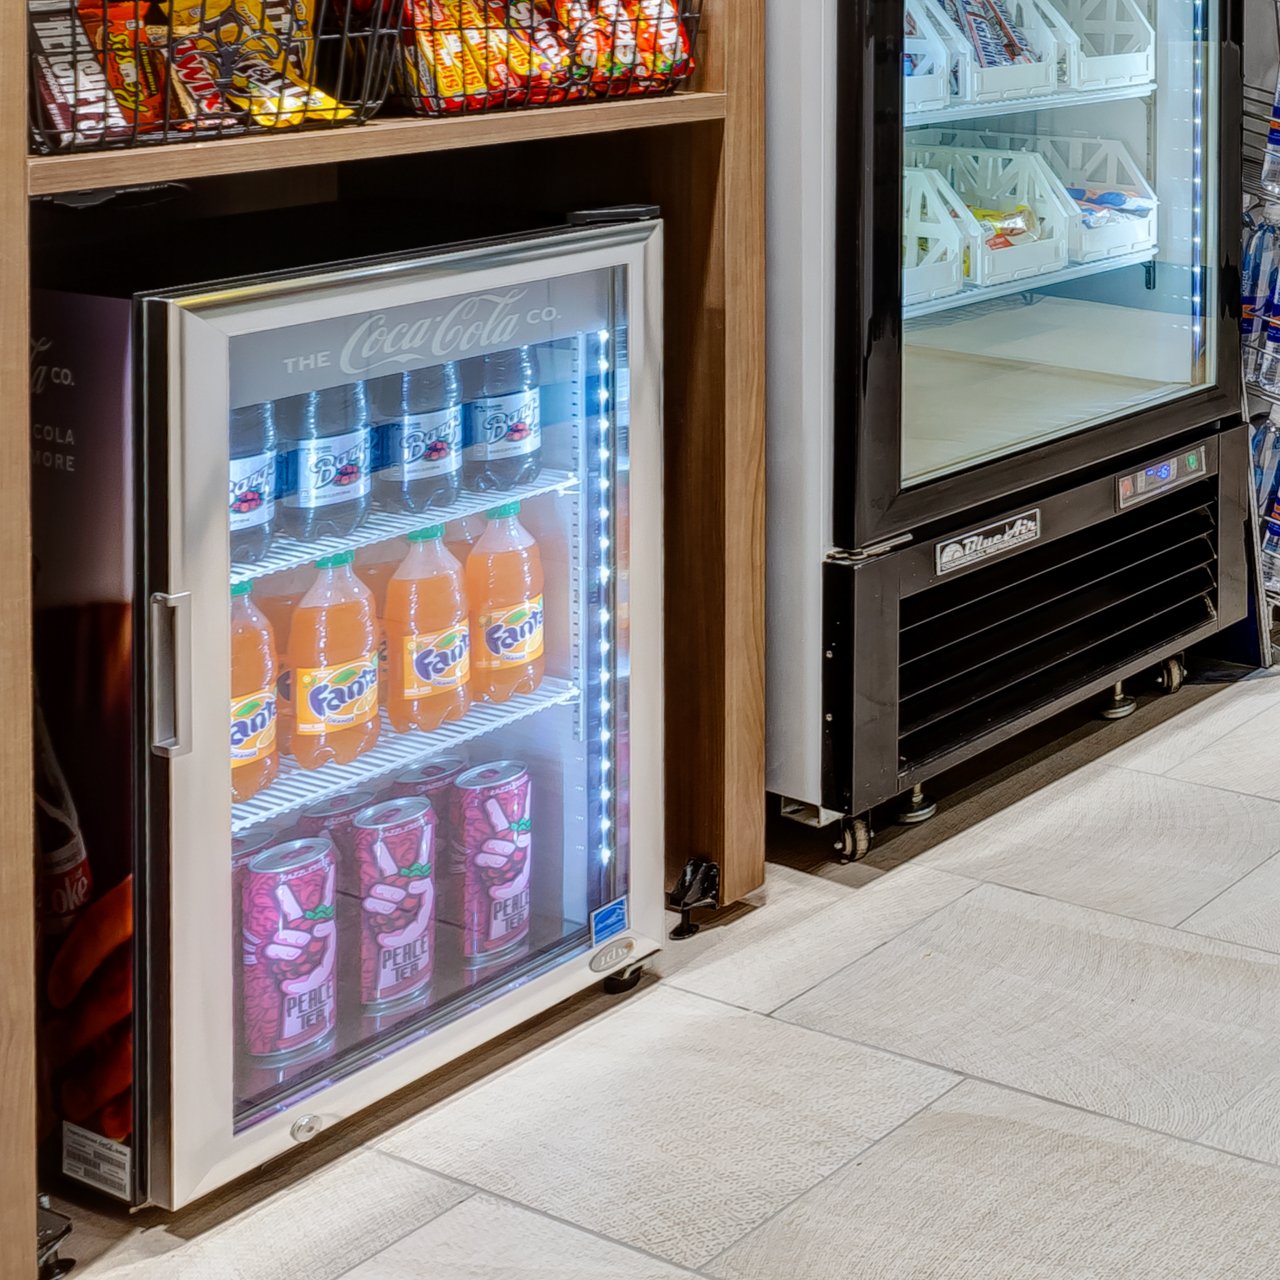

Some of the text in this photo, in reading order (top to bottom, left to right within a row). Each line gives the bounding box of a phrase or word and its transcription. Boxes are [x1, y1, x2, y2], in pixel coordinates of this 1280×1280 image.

[282, 350, 331, 374] THE
[526, 307, 562, 324] CO.
[51, 367, 75, 386] CO.
[33, 424, 75, 445] COLA
[962, 517, 1038, 555] Blue Air
[414, 632, 470, 682] Fant
[308, 668, 377, 718] Fanta
[53, 874, 89, 917] oke
[382, 934, 428, 970] PEACE
[392, 963, 420, 983] TEA
[286, 980, 333, 1018] PEACE
[299, 1008, 327, 1030] TEA
